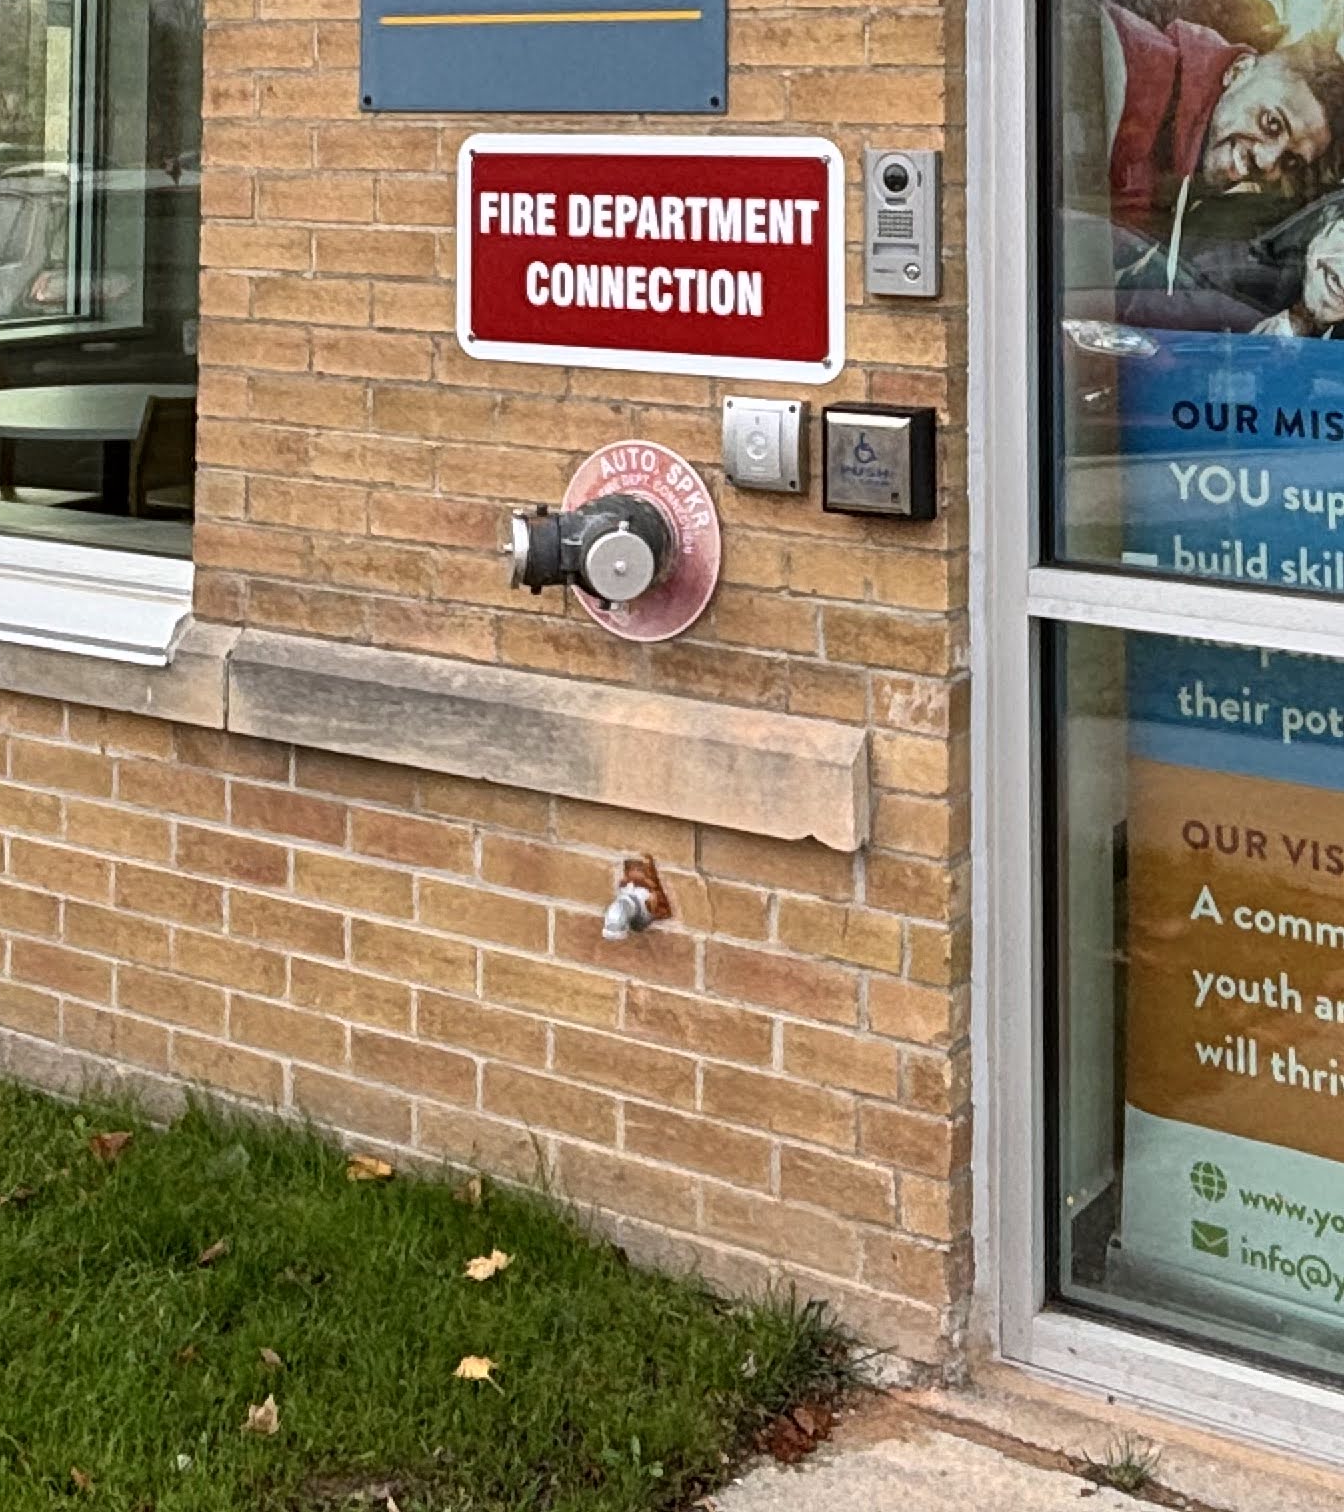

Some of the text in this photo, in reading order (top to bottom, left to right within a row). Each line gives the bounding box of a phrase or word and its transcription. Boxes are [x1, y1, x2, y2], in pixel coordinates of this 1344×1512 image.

[479, 192, 820, 245] FIRE DEPARTMENT
[526, 261, 763, 317] CONNECTION
[1172, 400, 1258, 435] OUR
[1170, 463, 1270, 508] YOU
[1173, 537, 1268, 581] build
[1178, 681, 1269, 726] their
[1182, 819, 1266, 858] OUR
[1190, 885, 1223, 925] A
[1192, 969, 1302, 1013] youth
[1195, 1037, 1258, 1078] will
